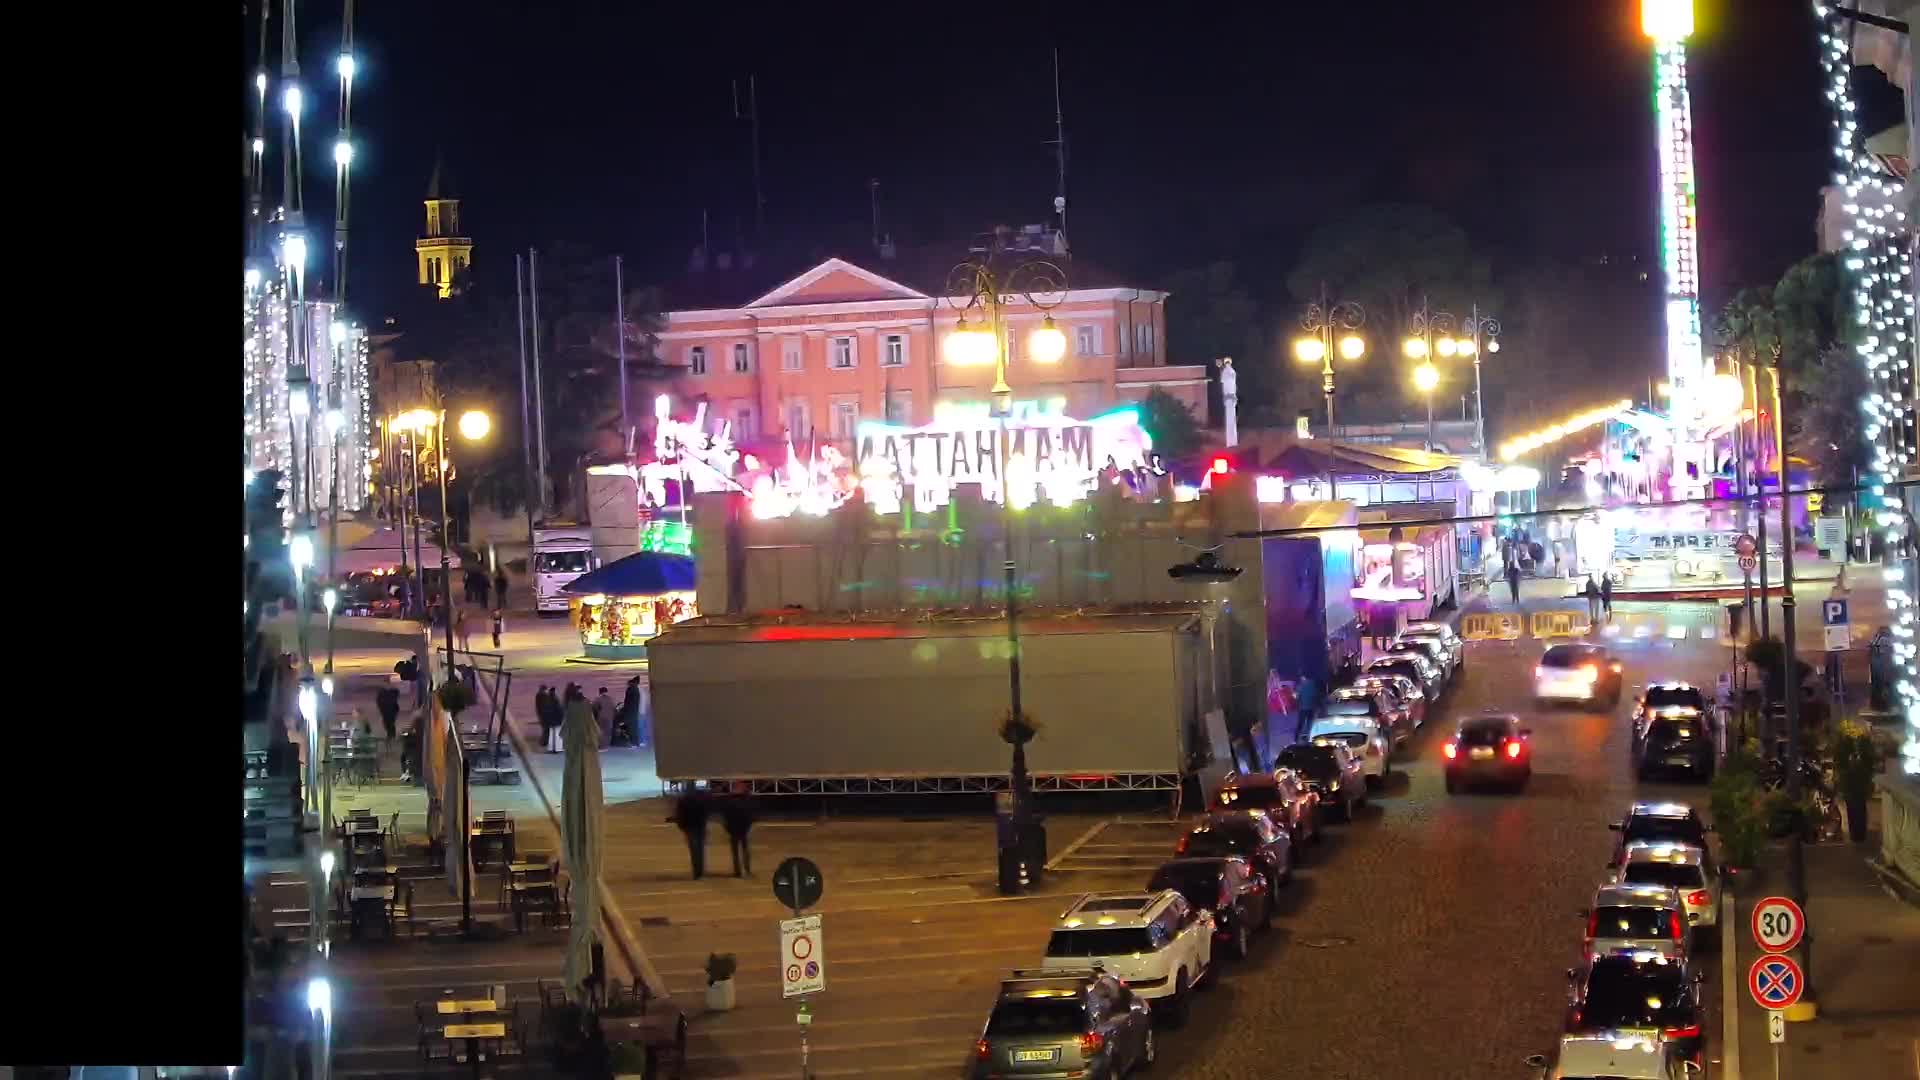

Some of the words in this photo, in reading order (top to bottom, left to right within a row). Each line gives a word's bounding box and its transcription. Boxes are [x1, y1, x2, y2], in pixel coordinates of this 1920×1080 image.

[1741, 557, 1753, 568] 20
[1826, 603, 1842, 622] P
[1763, 912, 1791, 938] 30
